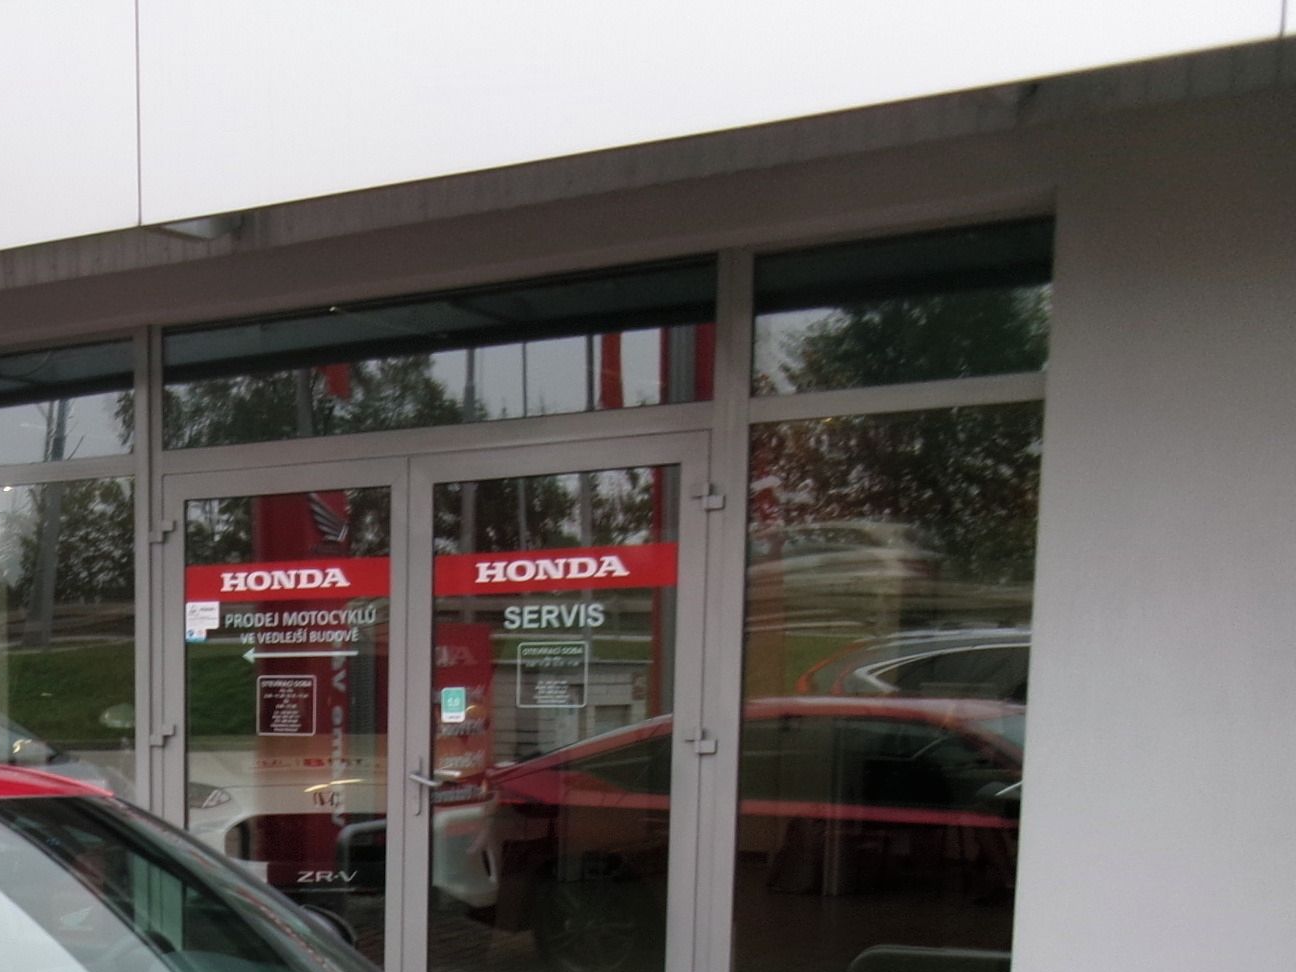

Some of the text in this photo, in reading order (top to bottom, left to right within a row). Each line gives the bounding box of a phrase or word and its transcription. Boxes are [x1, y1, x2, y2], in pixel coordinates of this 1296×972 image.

[220, 567, 351, 593] HONDA
[474, 555, 630, 584] HONDA
[224, 611, 279, 628] PRODEJ
[282, 604, 377, 627] MOTOCYKLŮ
[504, 603, 605, 630] SERVIS
[240, 628, 360, 645] VE VEDLEJŠÍ BUDOVĚ
[297, 870, 358, 883] ZR-V
